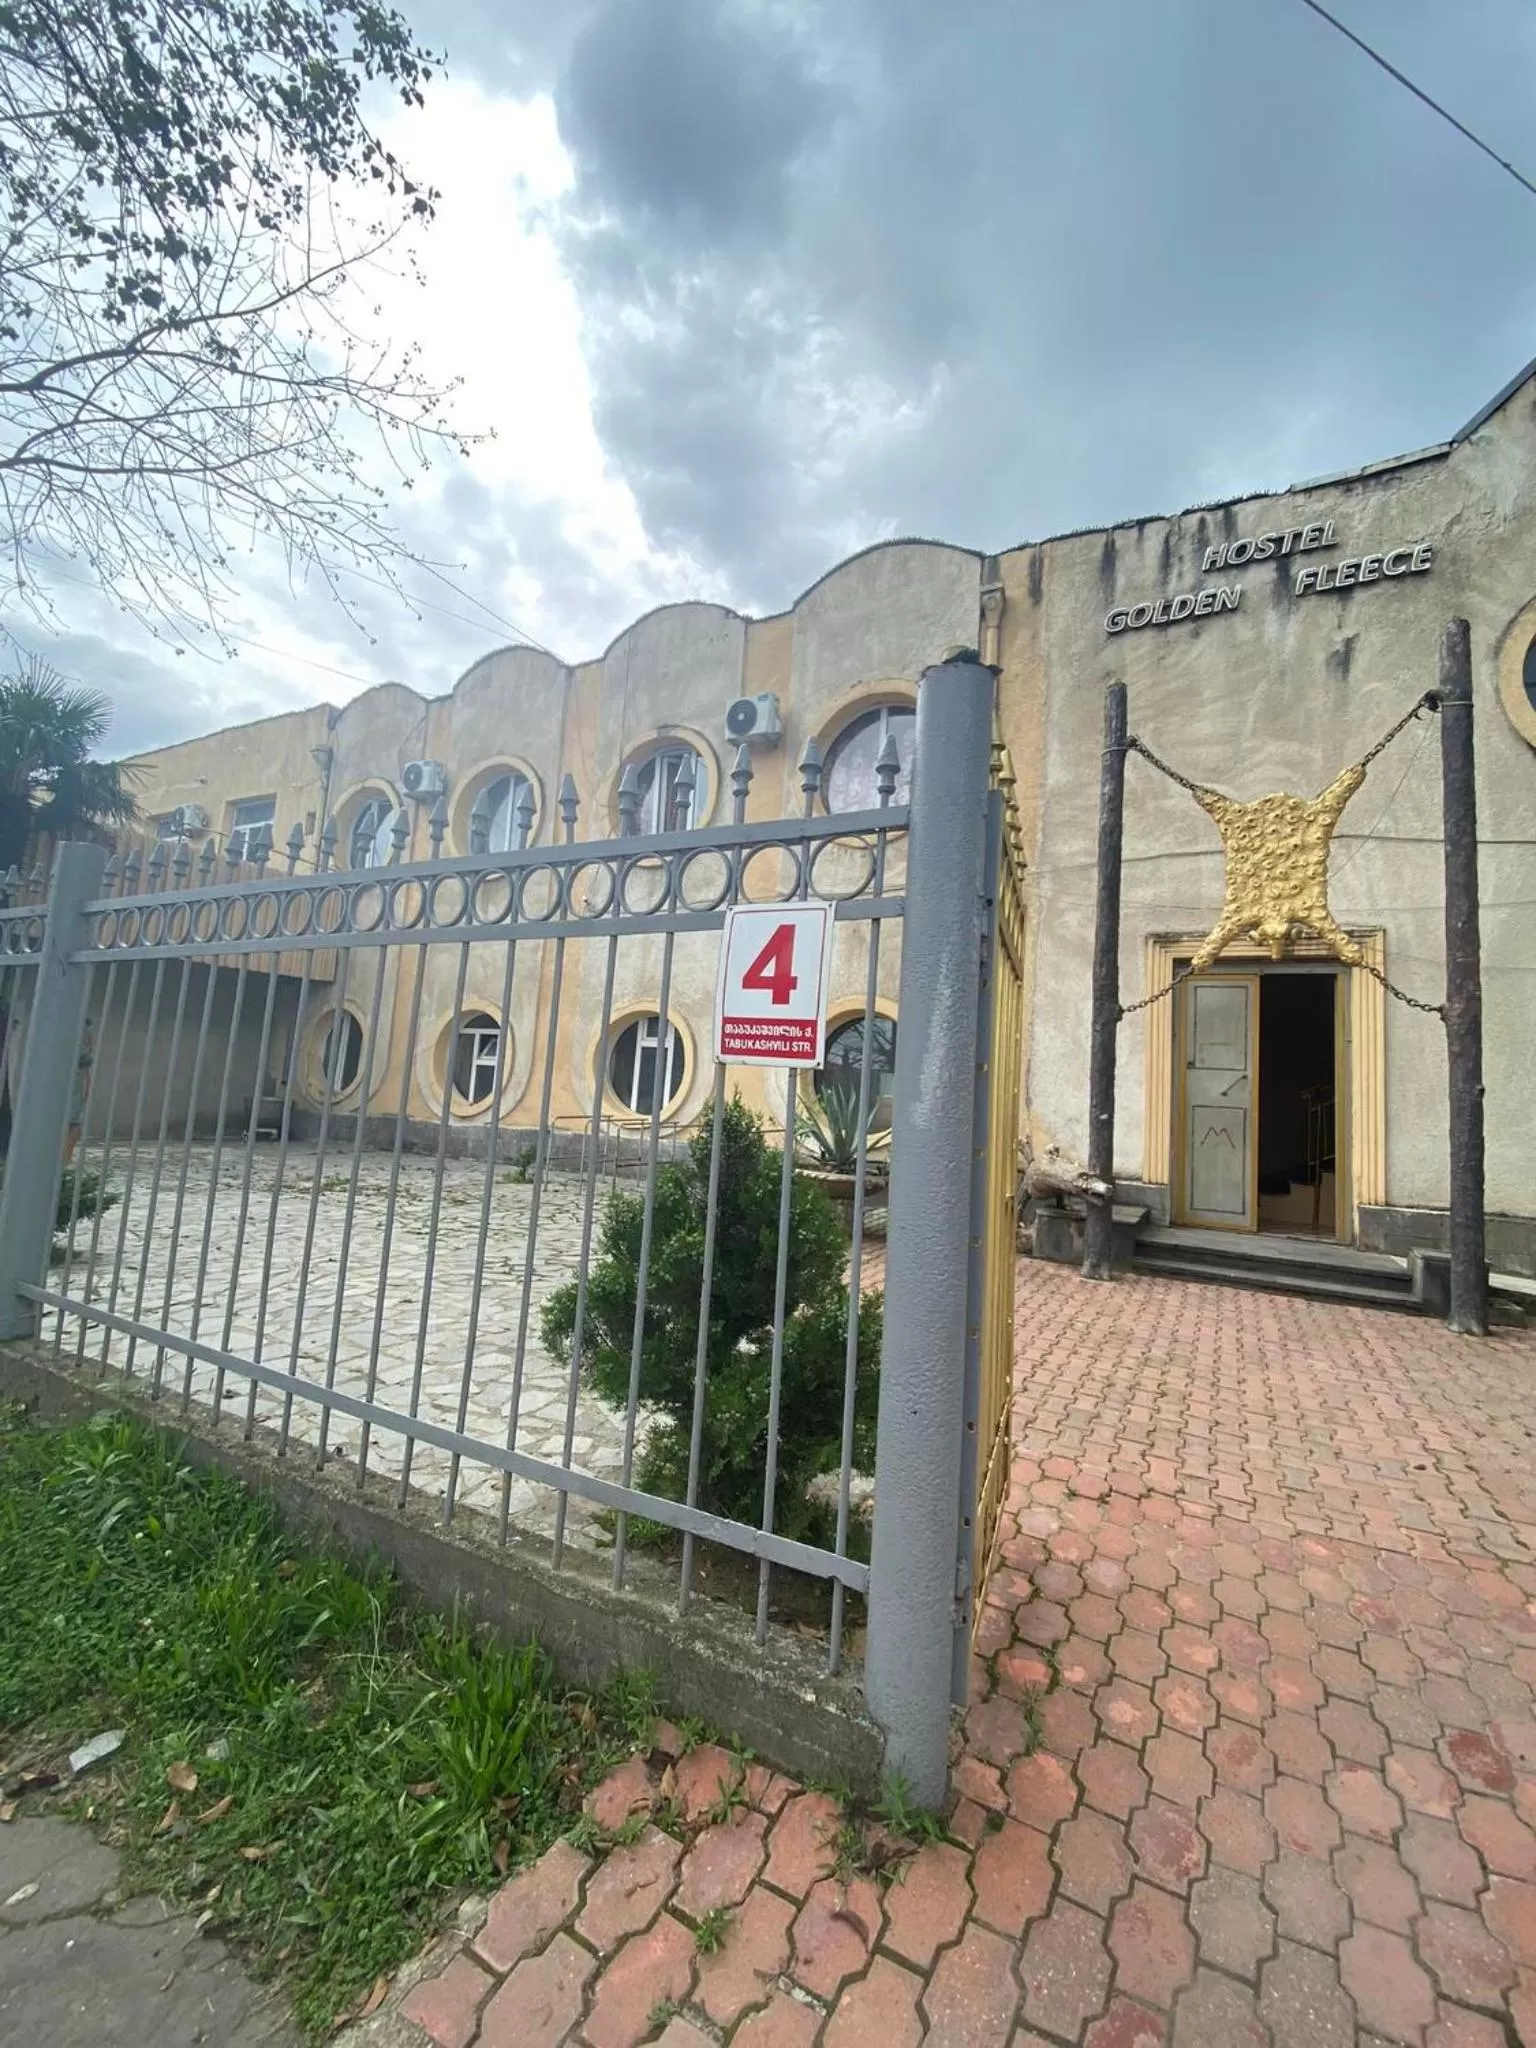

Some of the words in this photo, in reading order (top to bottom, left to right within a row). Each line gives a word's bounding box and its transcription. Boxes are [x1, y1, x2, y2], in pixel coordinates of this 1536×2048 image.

[1202, 519, 1339, 571] HOSTEL
[1104, 583, 1242, 633] GOLDEN
[1295, 542, 1433, 597] FLEECE
[742, 924, 798, 1005] 4
[724, 1038, 790, 1051] TABUKASHVILI
[791, 1041, 812, 1052] STR.
